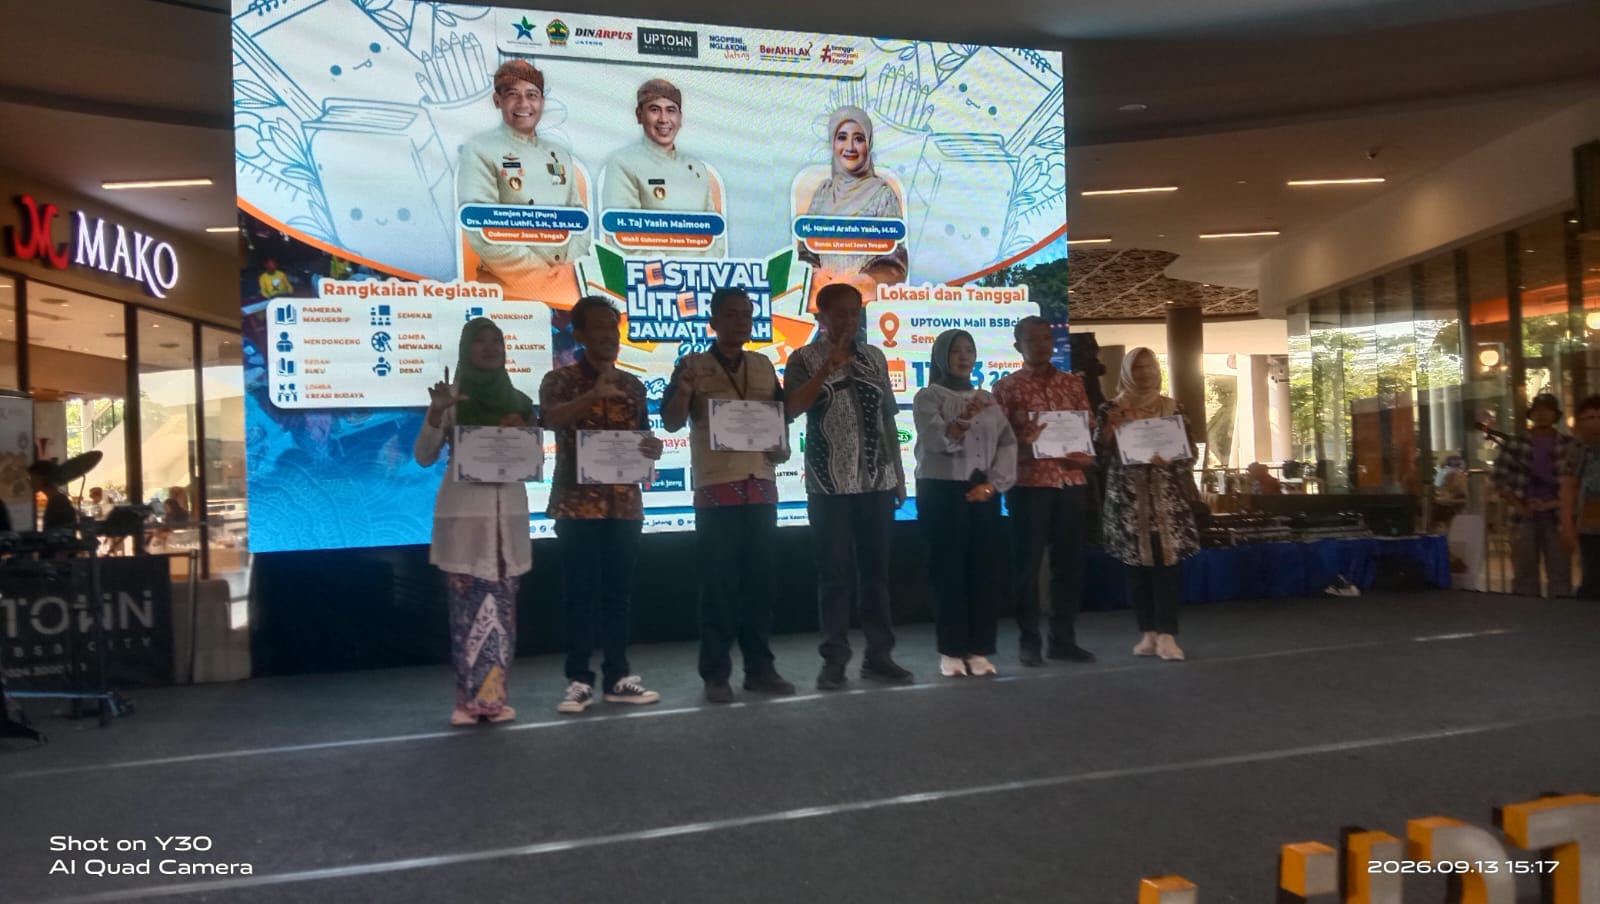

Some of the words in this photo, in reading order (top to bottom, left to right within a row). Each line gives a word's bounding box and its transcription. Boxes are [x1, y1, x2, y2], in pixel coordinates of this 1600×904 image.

[575, 27, 633, 40] DINARPUS
[643, 32, 692, 48] UPTOWN
[617, 218, 627, 226] H.
[628, 218, 643, 228] Taj
[644, 219, 668, 228] Yasin
[670, 220, 711, 229] Maimoen
[836, 225, 860, 233] Arafah
[75, 210, 178, 299] MAKO
[627, 260, 769, 287] FESTIVAL
[323, 282, 418, 300] Rangkaian
[423, 283, 499, 300] Kegiatan
[880, 287, 930, 301] Lokasi
[934, 288, 962, 301] dan
[966, 288, 1025, 304] Tanggal
[628, 291, 770, 317] LITERSI
[630, 322, 688, 338] JAWA
[911, 317, 961, 328] UPTOWN
[964, 317, 986, 328] Mall
[989, 316, 1020, 328] BSBci
